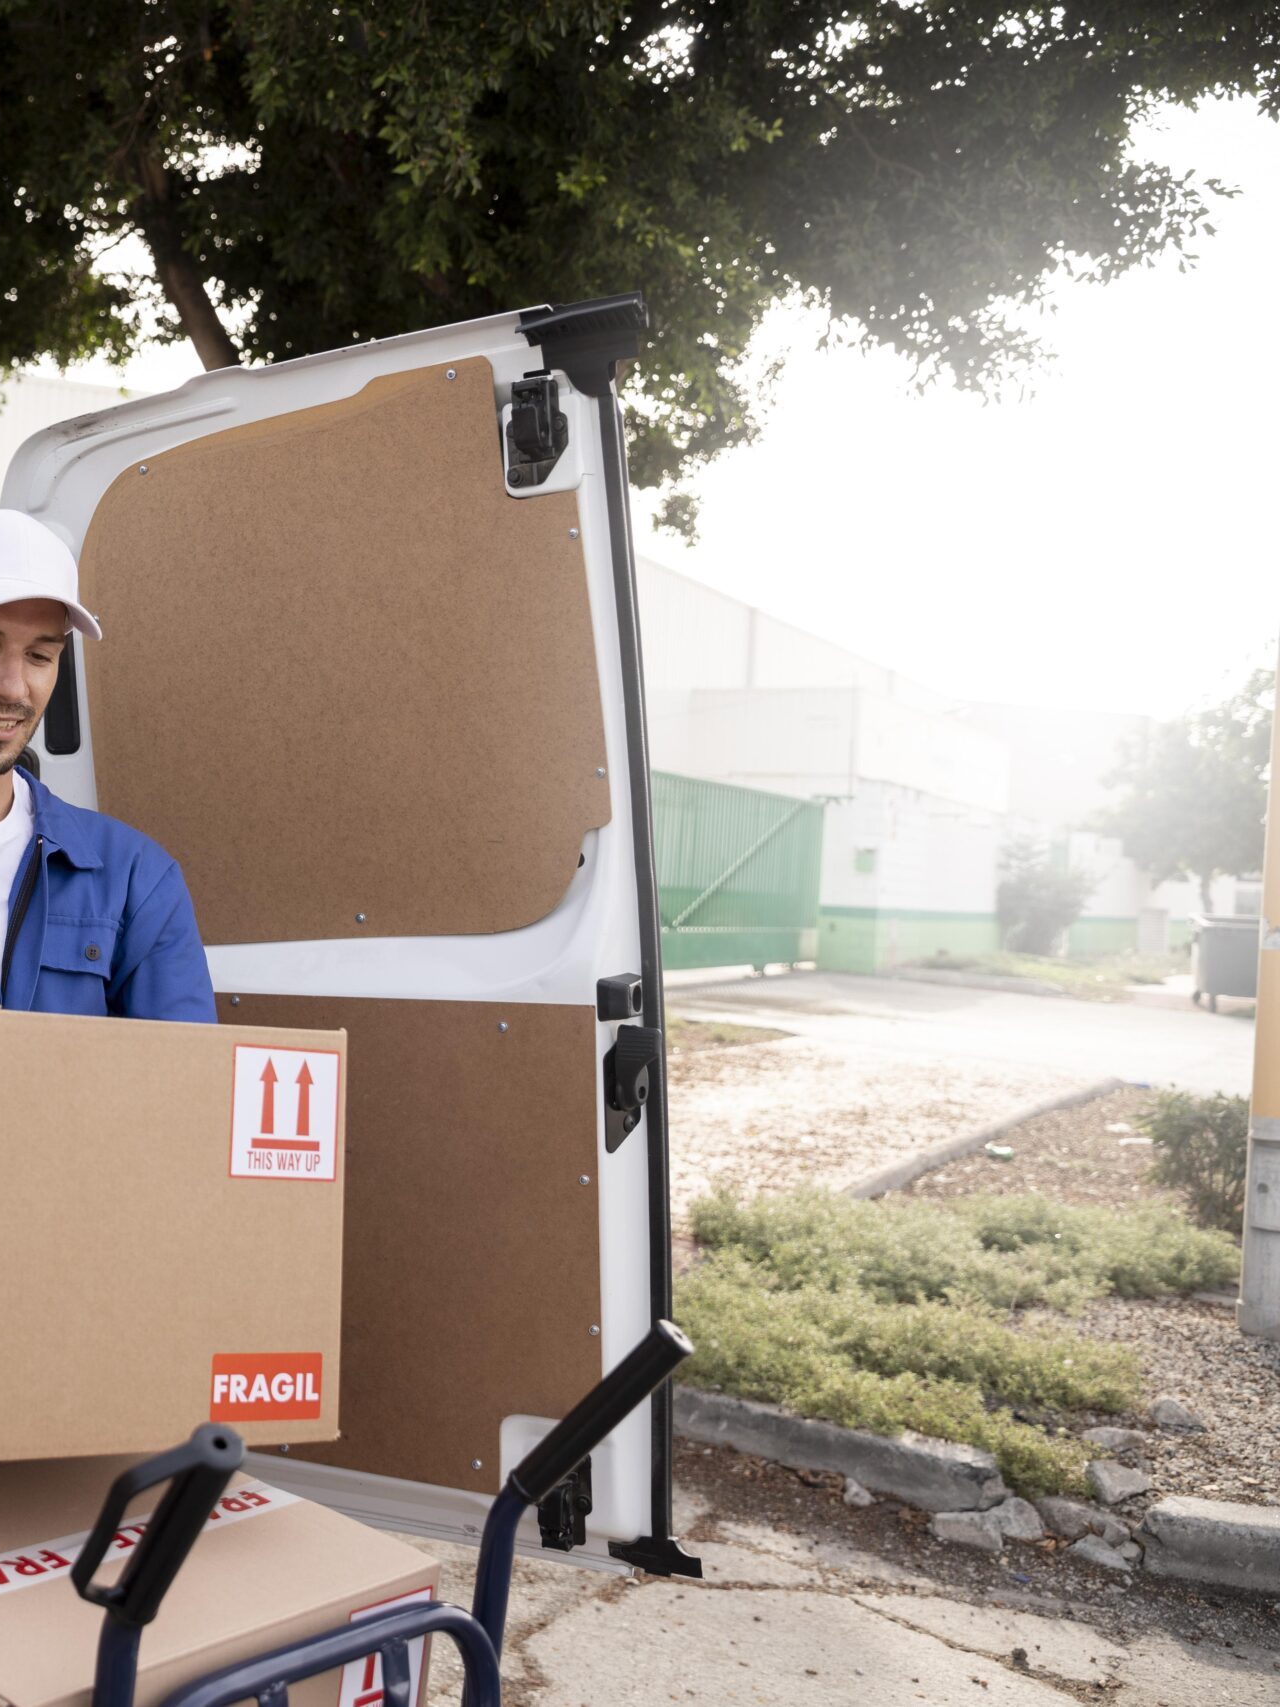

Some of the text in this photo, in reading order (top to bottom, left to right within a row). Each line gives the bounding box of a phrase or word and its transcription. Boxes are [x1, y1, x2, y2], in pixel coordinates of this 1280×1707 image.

[246, 1150, 321, 1173] THIS WAY UP
[213, 1372, 320, 1404] FRAGIL
